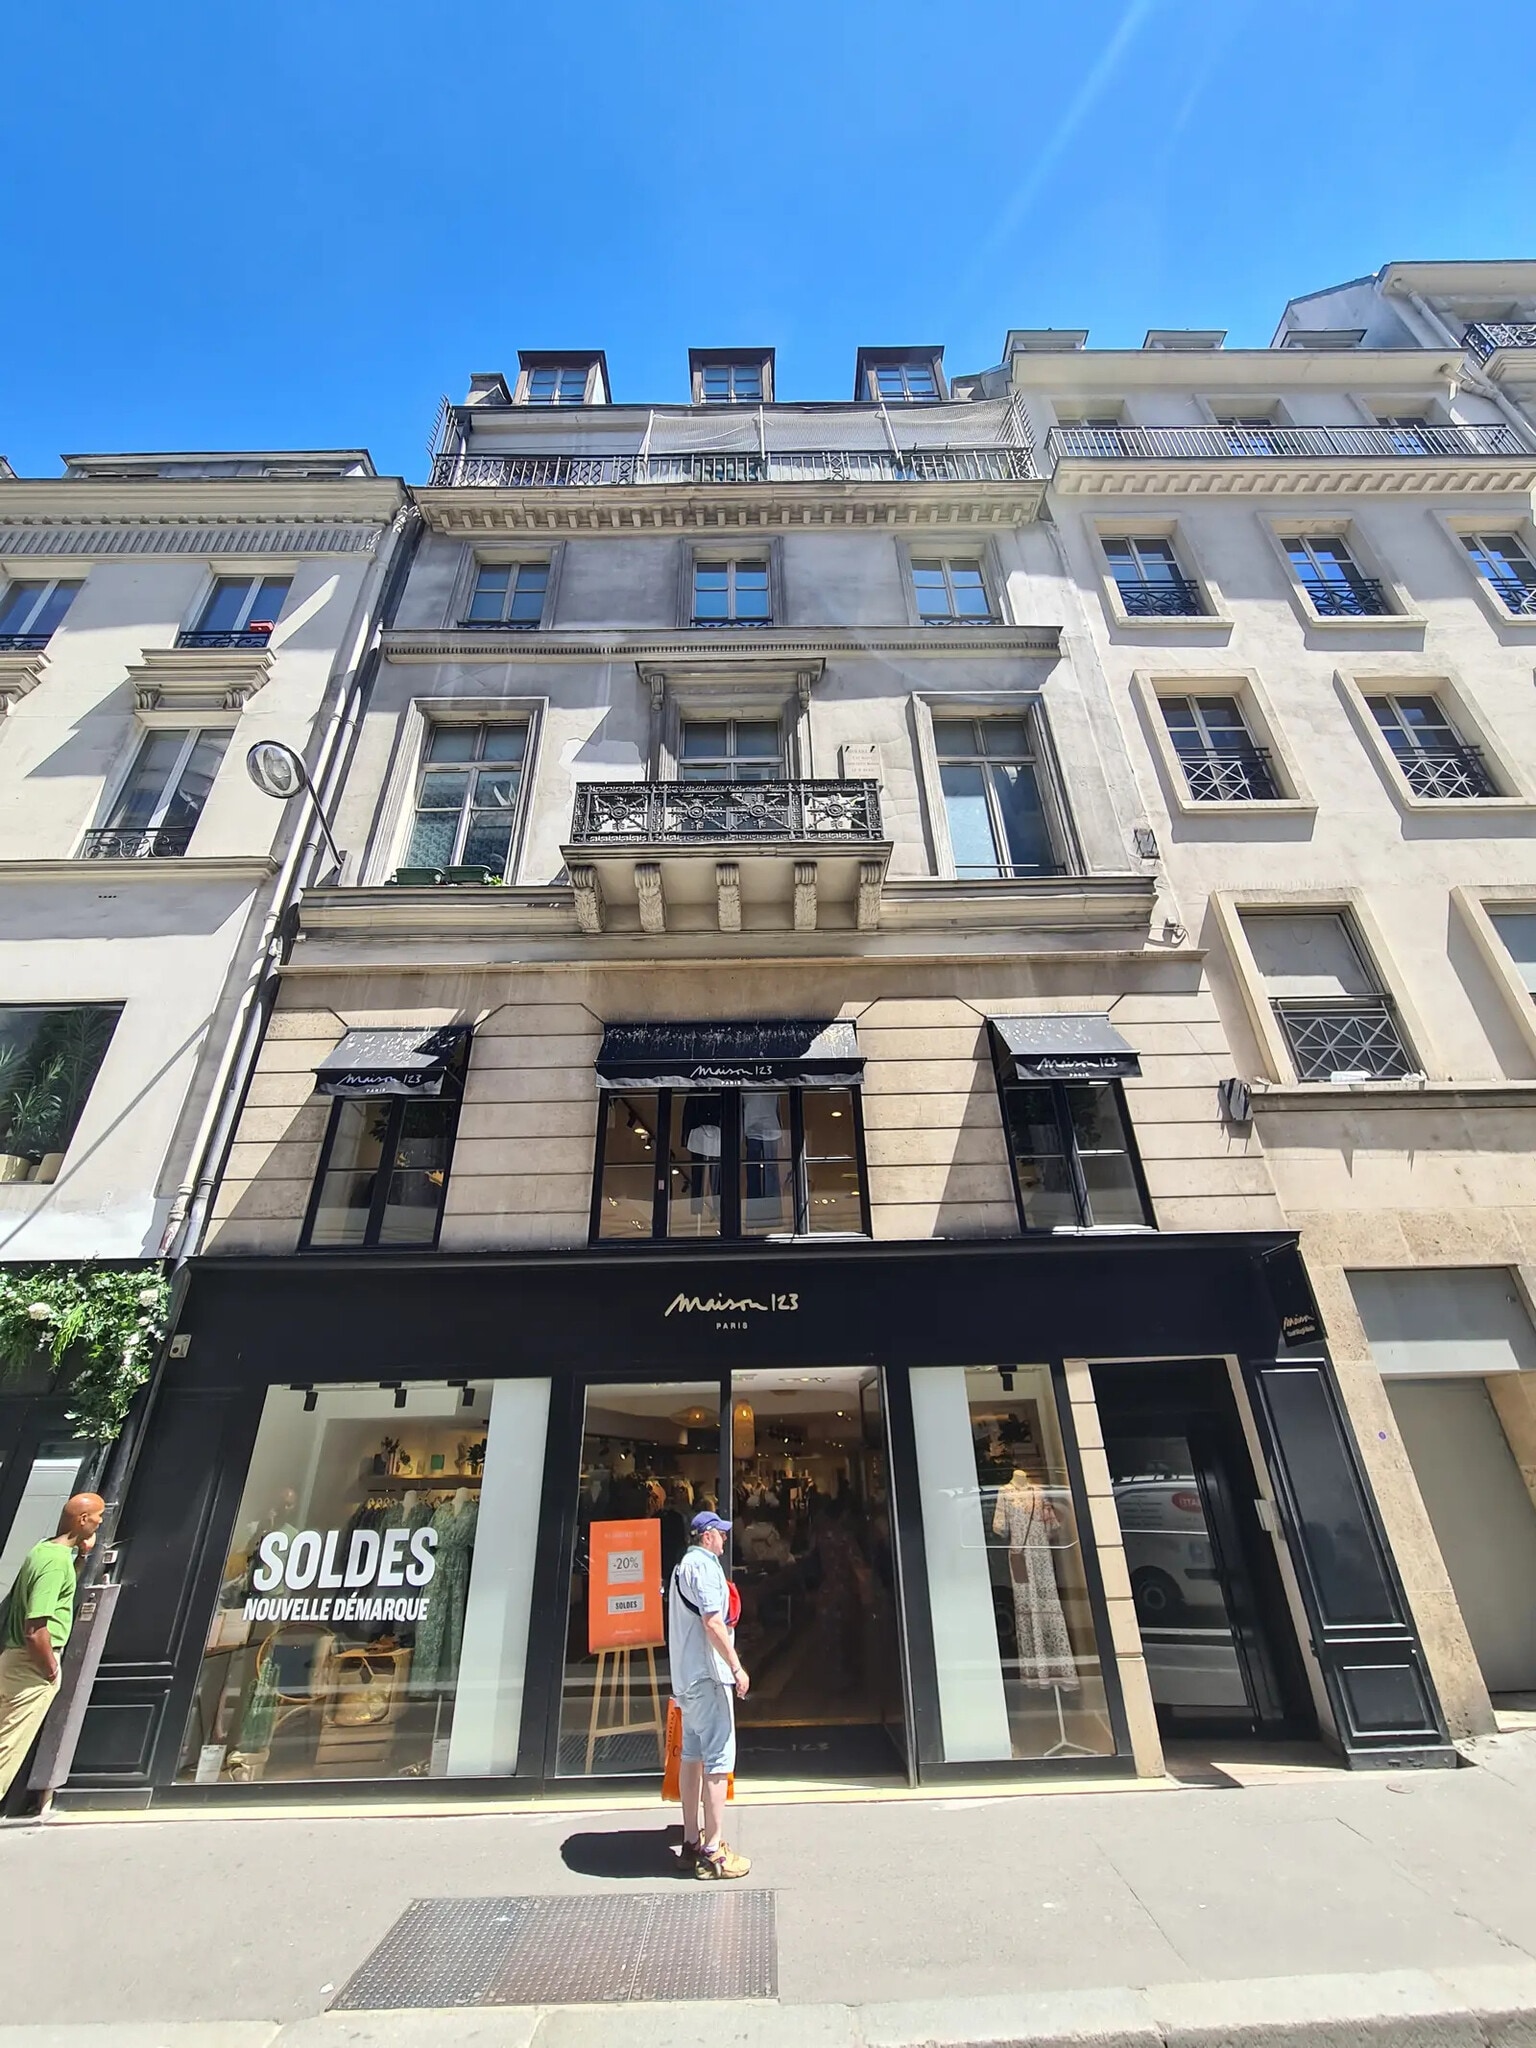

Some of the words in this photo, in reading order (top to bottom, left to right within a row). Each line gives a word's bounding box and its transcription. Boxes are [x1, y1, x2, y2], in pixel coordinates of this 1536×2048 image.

[1100, 1057, 1119, 1068] 123
[689, 1065, 754, 1078] Maison
[755, 1065, 773, 1075] 123
[336, 1073, 401, 1086] Maison
[403, 1074, 422, 1084] 123
[664, 1292, 769, 1317] Maison
[771, 1293, 799, 1312] 123
[716, 1322, 748, 1330] PARIS
[253, 1527, 439, 1592] SOLDES
[613, 1556, 640, 1570] -20%
[242, 1597, 333, 1622] NOUVELLE
[332, 1592, 431, 1622] DÉMARQUE
[615, 1600, 638, 1610] SOLDES
